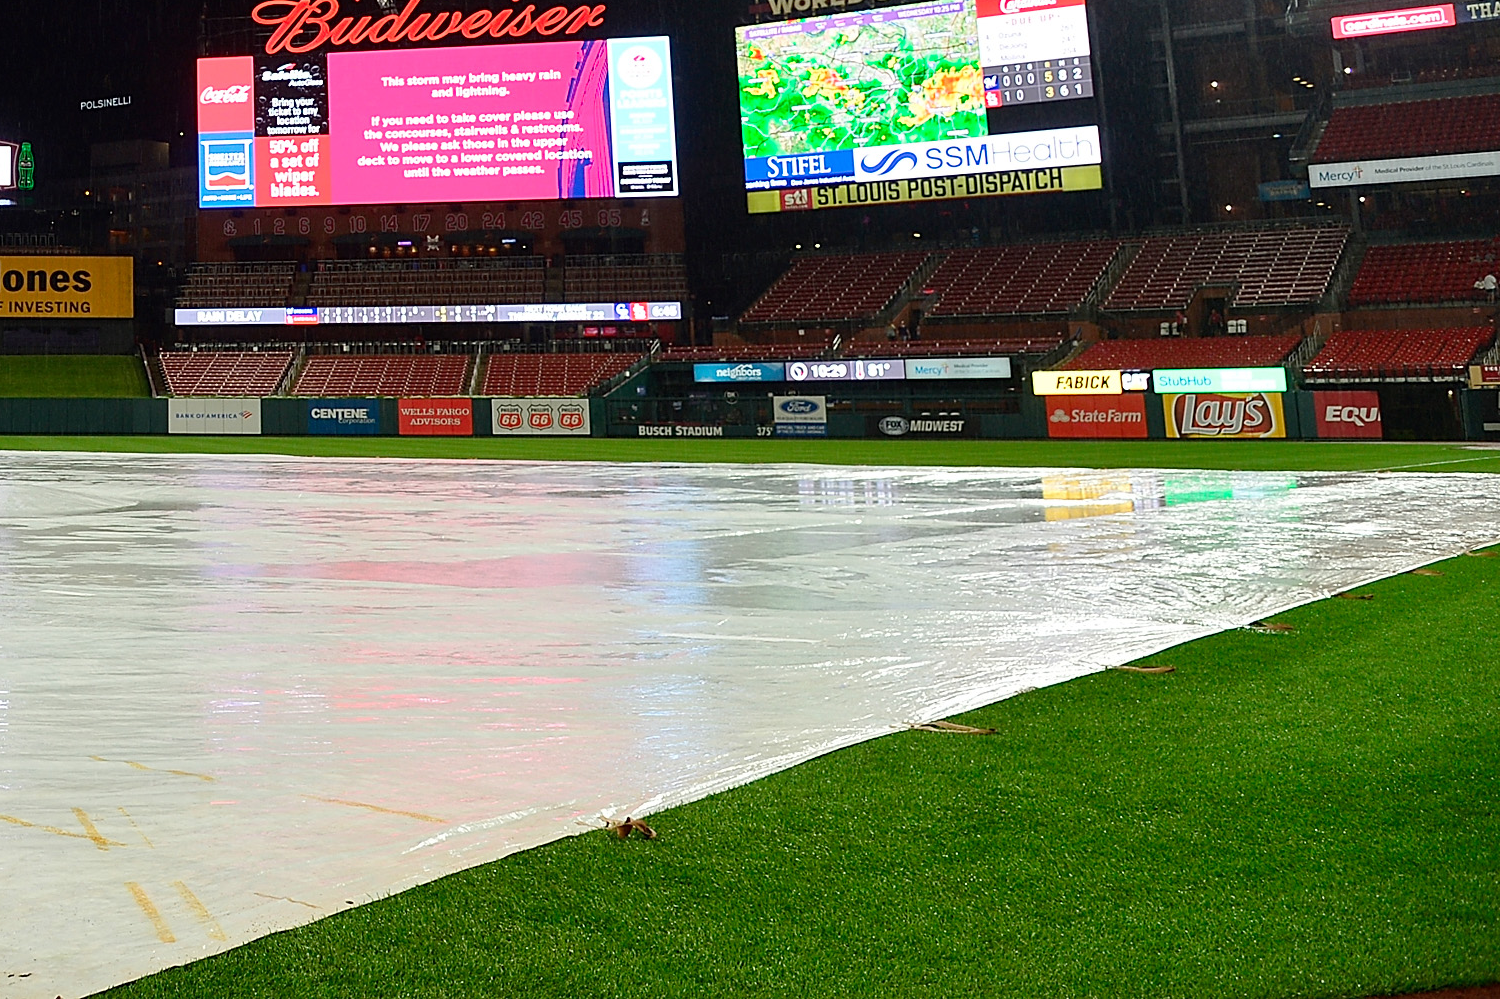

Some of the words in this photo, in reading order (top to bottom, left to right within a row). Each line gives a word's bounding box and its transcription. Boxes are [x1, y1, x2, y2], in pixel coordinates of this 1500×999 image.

[1345, 12, 1440, 32] cardinals.com
[381, 76, 405, 87] This
[407, 75, 440, 86] storm
[442, 75, 466, 86] may
[468, 72, 499, 85] bring
[501, 71, 537, 83] heavy
[538, 69, 561, 80] rain
[431, 87, 453, 98] and
[455, 85, 510, 99] lightning.
[80, 96, 131, 111] POLSINELLI
[271, 98, 294, 109] Bring
[295, 98, 315, 109] your
[277, 116, 310, 126] location
[371, 116, 381, 127] If
[382, 117, 403, 128] you
[405, 114, 434, 125] need
[436, 114, 449, 124] to
[451, 112, 477, 123] take
[478, 113, 511, 123] cover
[513, 110, 551, 123] please
[553, 110, 575, 120] use
[267, 126, 307, 135] tomorrow
[308, 124, 320, 134] for
[363, 129, 382, 140] the
[385, 127, 452, 140] concourses,
[454, 125, 509, 136] stairwells
[510, 124, 519, 135] &
[521, 122, 584, 134] restrooms.
[269, 139, 298, 154] 50%
[300, 138, 319, 153] off
[380, 141, 399, 152] We
[401, 140, 439, 153] please
[440, 140, 460, 150] ask
[462, 138, 495, 149] those
[497, 138, 509, 148] in
[510, 137, 531, 147] the
[532, 136, 568, 149] upper
[357, 155, 385, 166] deck
[387, 156, 400, 165] to
[402, 155, 433, 165] move
[435, 154, 448, 164] to
[450, 154, 458, 163] a
[460, 152, 493, 163] lower
[495, 150, 542, 162] covered
[544, 148, 593, 160] location
[403, 167, 429, 178] until
[431, 166, 451, 177] the
[453, 165, 500, 177] weather
[502, 164, 545, 177] passes.
[767, 154, 831, 178] STIFEL
[275, 168, 315, 185] wiper
[1319, 170, 1354, 183] Mercy
[270, 183, 319, 197] blades.
[817, 186, 846, 205] ST.
[847, 180, 899, 203] LOUIS
[908, 169, 1063, 201] POST-DISPATCH
[253, 218, 261, 235] 1
[273, 218, 285, 235] 2
[299, 217, 310, 234] 6
[324, 217, 336, 234] 9
[349, 216, 367, 233] 10
[380, 215, 399, 233] 14
[412, 214, 431, 232] 17
[445, 213, 469, 231] 20
[481, 212, 505, 230] 24
[520, 211, 544, 229] 42
[558, 211, 583, 229] 45
[597, 210, 622, 228] 85
[8, 301, 91, 314] INVESTING
[197, 310, 224, 323] RAIN
[226, 310, 263, 323] DELAY
[716, 367, 762, 379] neighbors
[915, 366, 942, 377] Mercy
[1056, 375, 1111, 389] FABICK
[1159, 376, 1212, 387] StubHub
[311, 408, 368, 420] CENTENE
[401, 408, 435, 416] WELLS
[436, 408, 470, 416] FARGO
[1182, 394, 1265, 436] Lay's
[1325, 405, 1381, 427] EQU
[410, 418, 461, 426] ADVISORS
[501, 415, 517, 425] 66
[532, 415, 548, 425] 66
[562, 415, 578, 425] 66
[910, 420, 964, 432] MIDWEST
[638, 425, 673, 436] BUSCH
[675, 425, 723, 436] STADIUM
